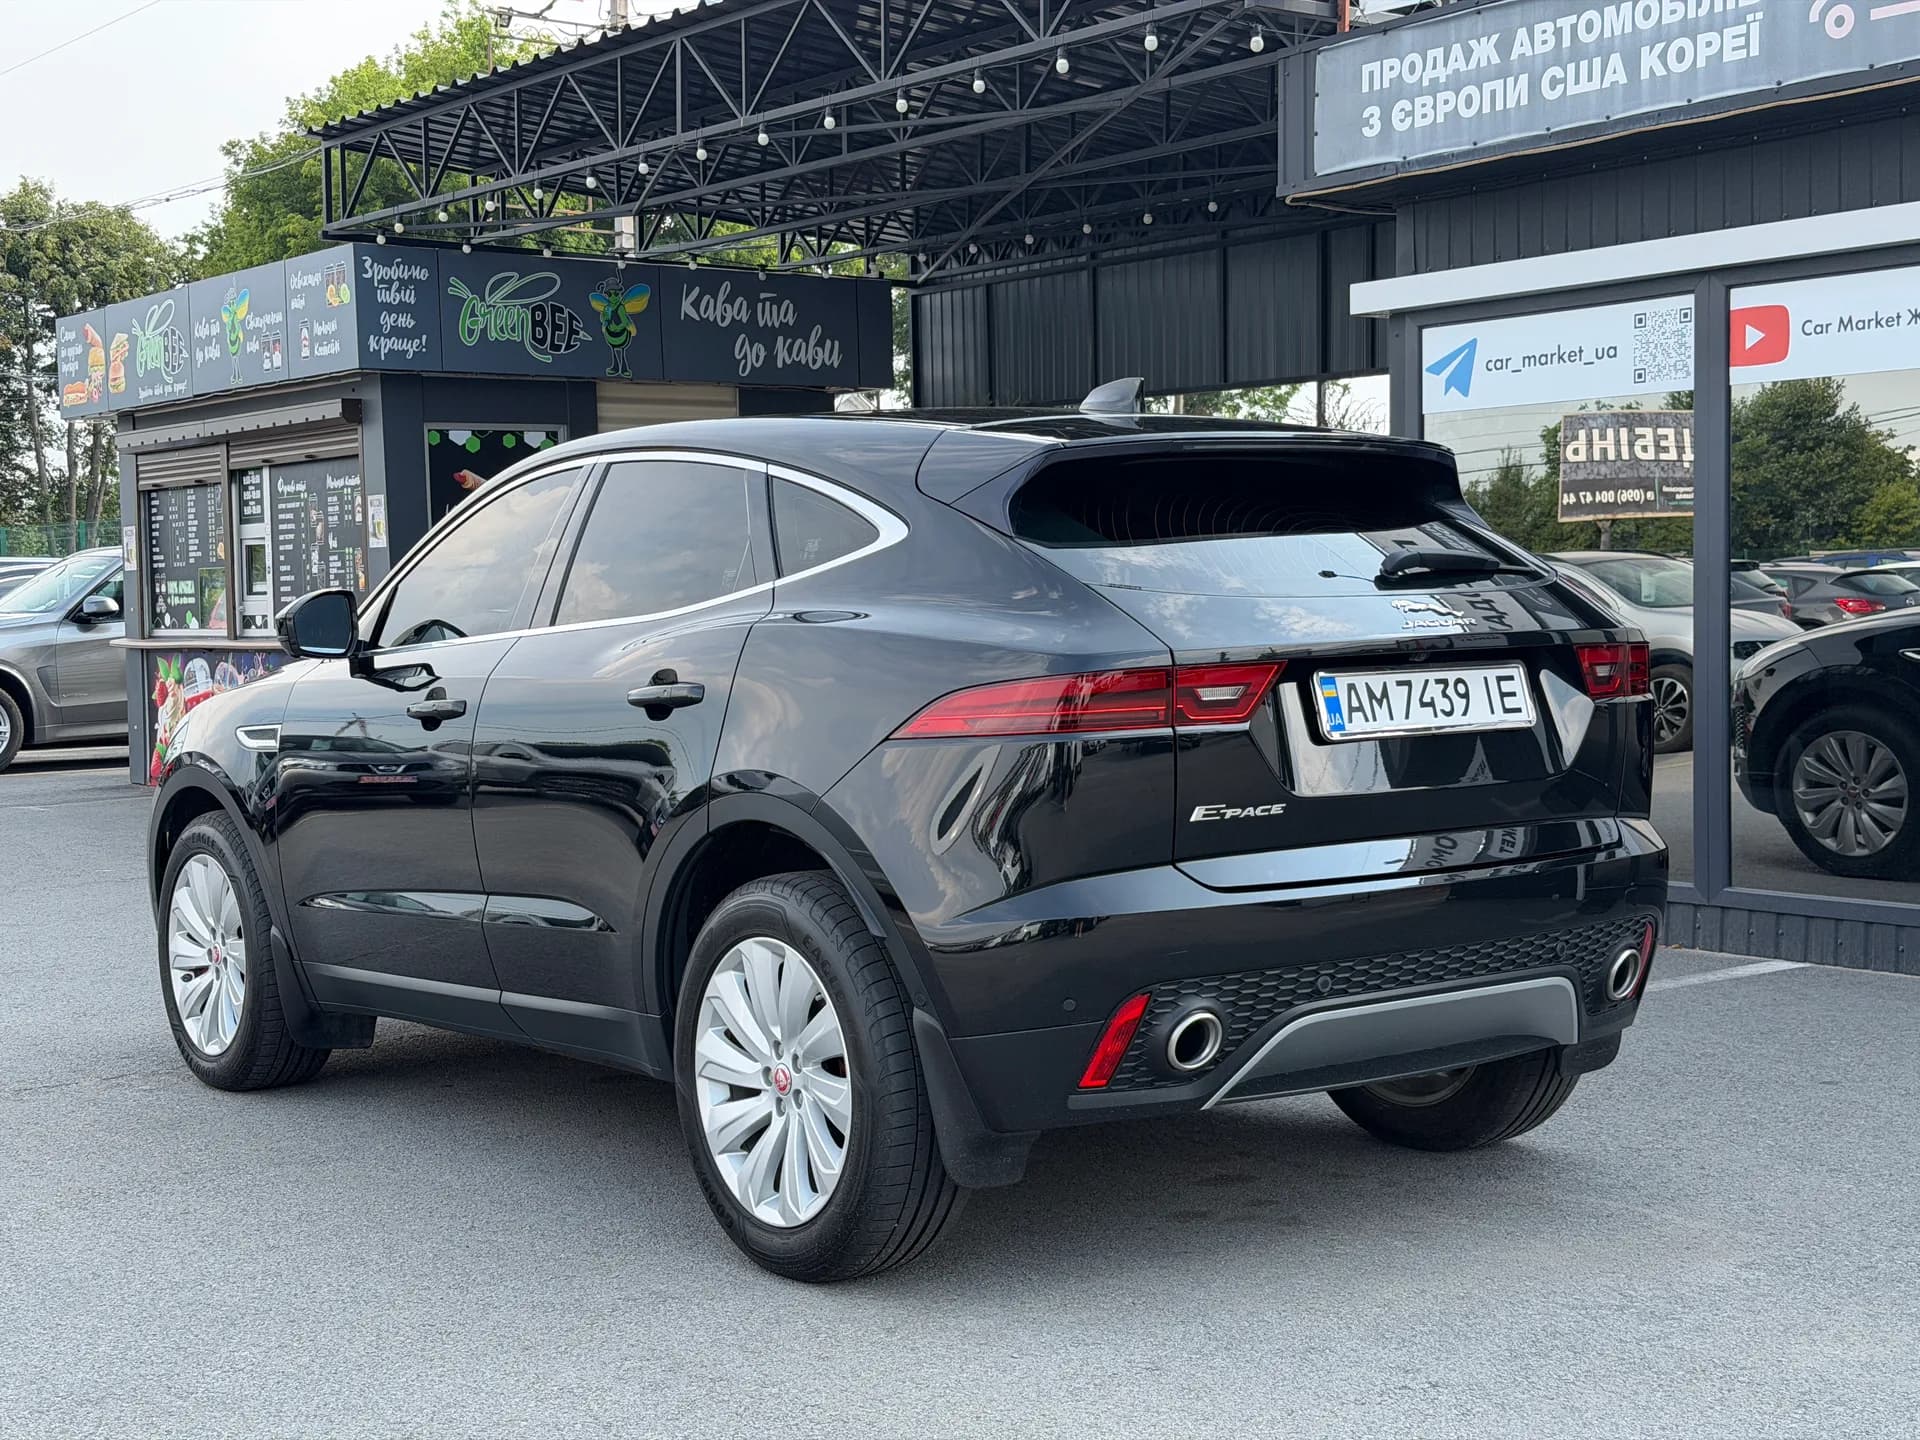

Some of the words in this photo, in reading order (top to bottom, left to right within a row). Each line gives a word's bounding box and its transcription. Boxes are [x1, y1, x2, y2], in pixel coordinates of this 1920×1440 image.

[1361, 36, 1501, 93] ПРОДАЖ
[1510, 0, 1760, 61] АВТОМОБІЛ
[1361, 105, 1382, 138] З
[1391, 73, 1529, 132] ЄВРОПИ
[1540, 52, 1628, 101] США
[1640, 12, 1764, 80] КОРЕЇ
[361, 255, 430, 288] Зробимо
[376, 280, 417, 305] твій
[680, 280, 751, 328] Кава
[756, 292, 798, 329] та
[379, 310, 417, 334] день
[1801, 319, 1832, 336] Car
[1837, 310, 1902, 333] Market
[367, 334, 427, 361] краще!
[734, 333, 767, 377] до
[773, 324, 843, 370] кави
[1485, 344, 1618, 373] car_market_ua
[1401, 617, 1478, 630] JAGUAR
[1327, 712, 1344, 727] UA
